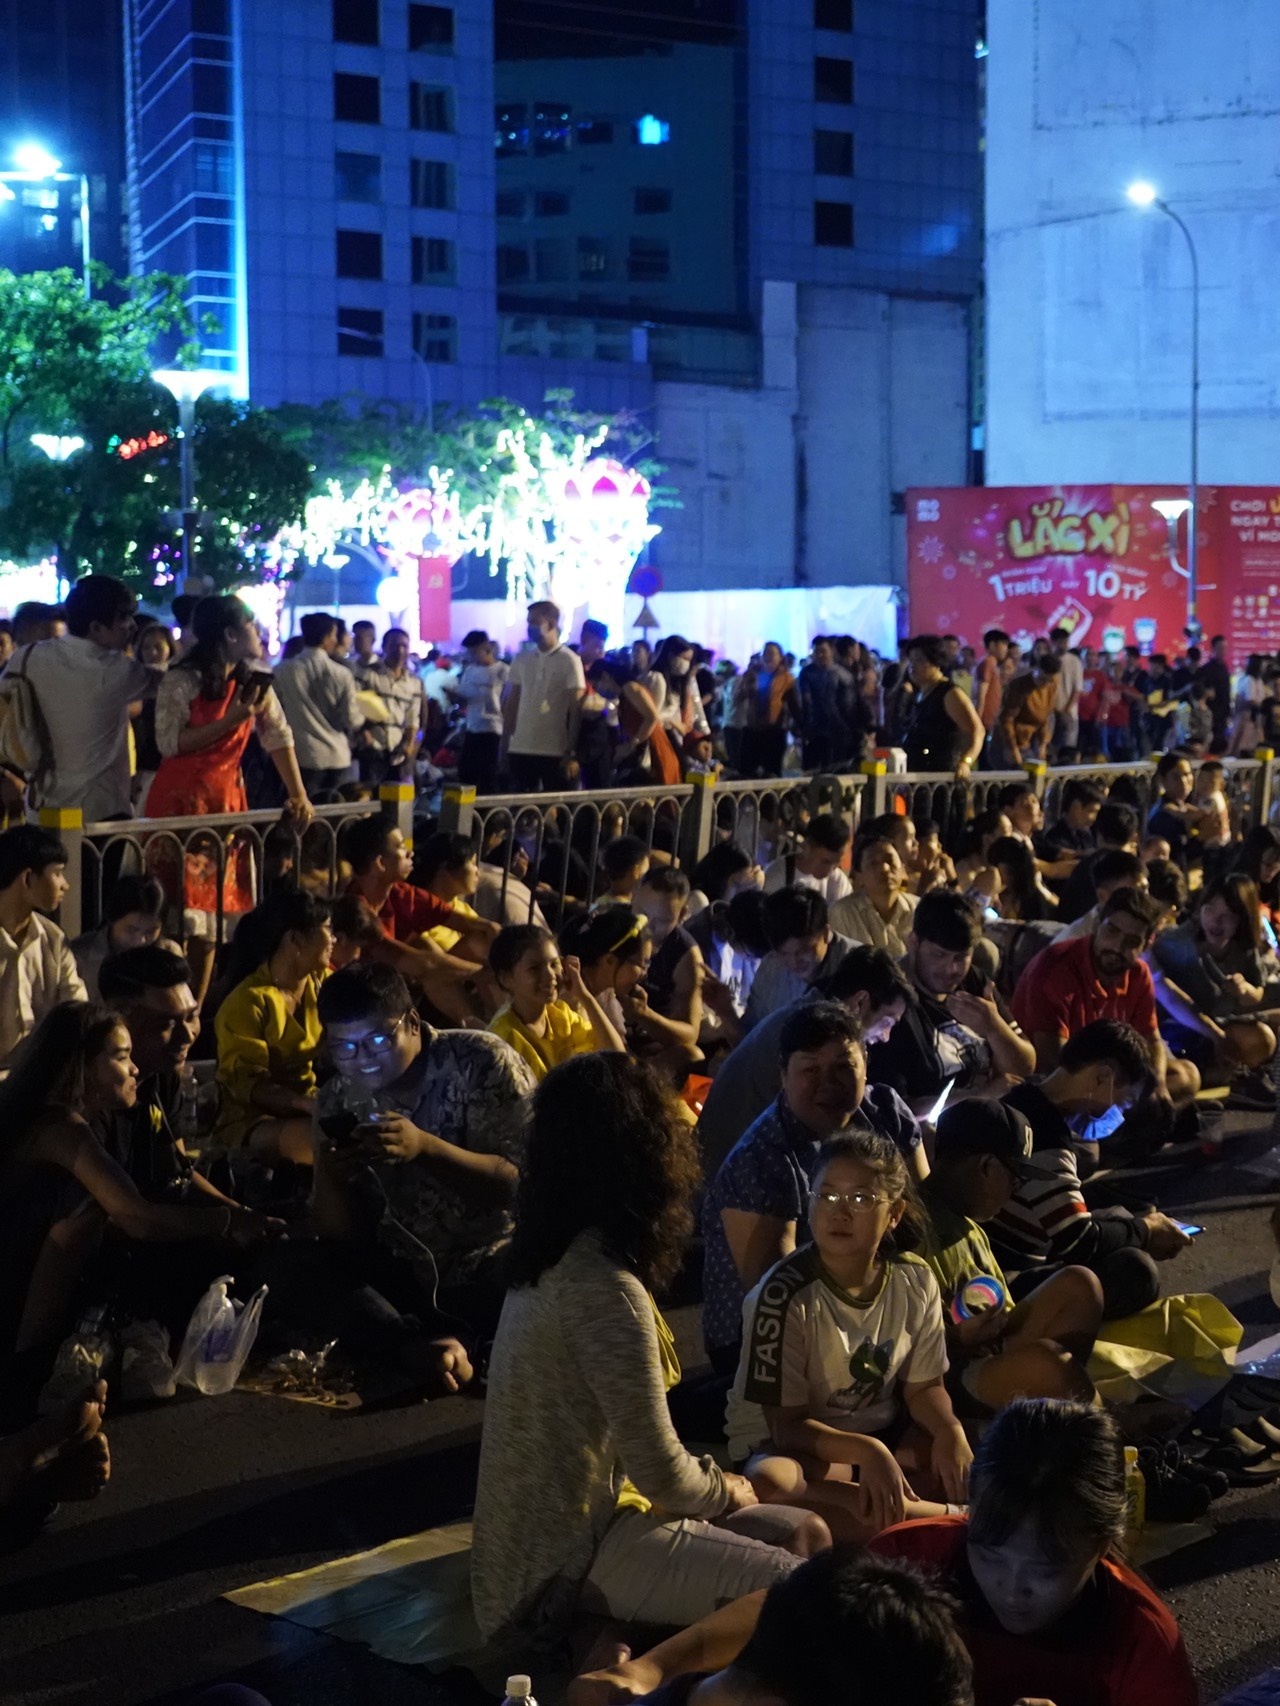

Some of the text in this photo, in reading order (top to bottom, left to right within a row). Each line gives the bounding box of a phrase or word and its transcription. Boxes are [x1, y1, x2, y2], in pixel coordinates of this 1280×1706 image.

[1230, 515, 1270, 528] NGAY
[988, 574, 1006, 602] 1
[1084, 568, 1121, 599] 10
[753, 1264, 805, 1384] FASION
